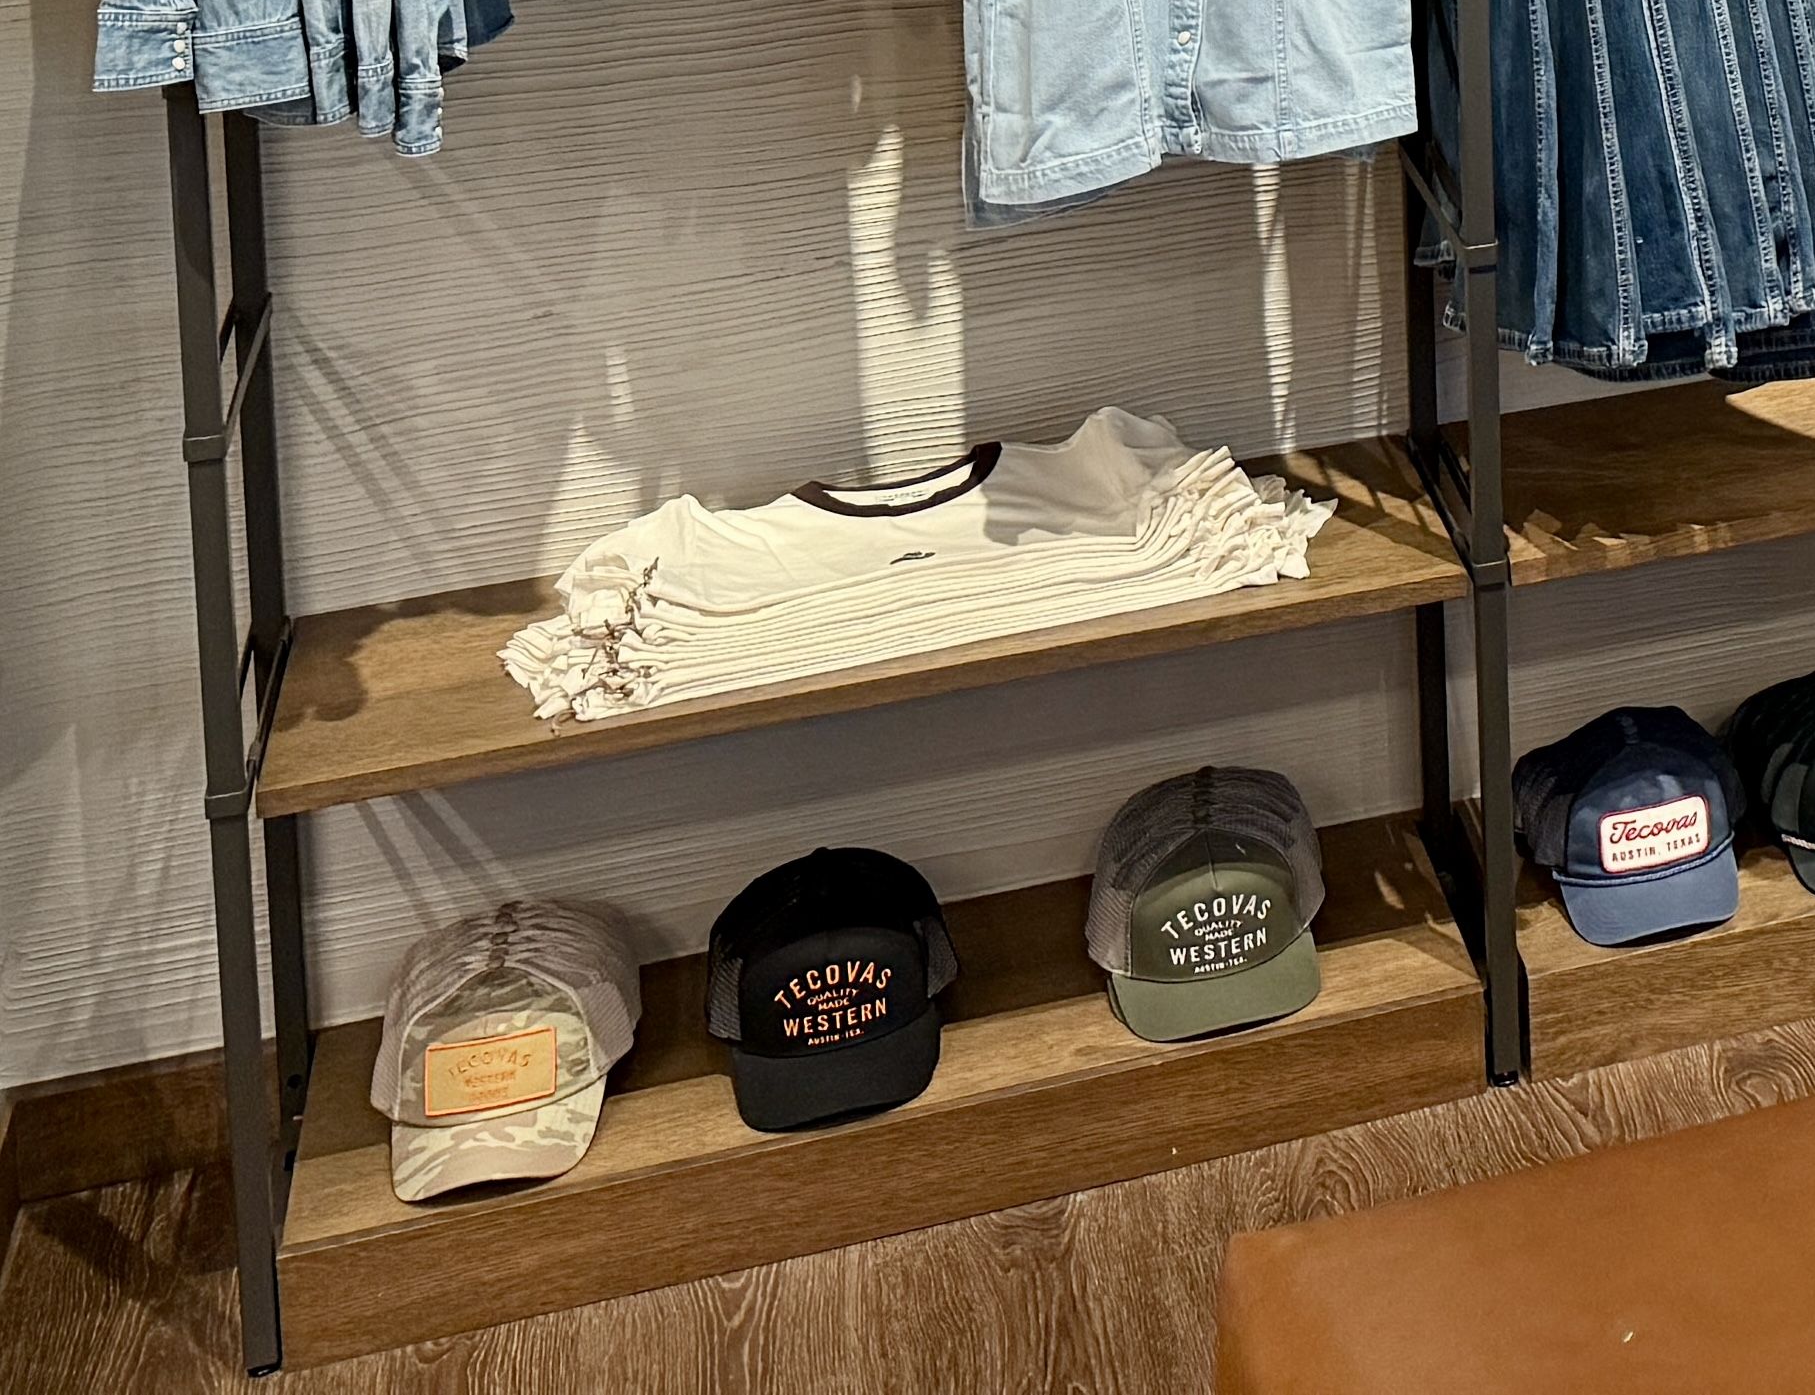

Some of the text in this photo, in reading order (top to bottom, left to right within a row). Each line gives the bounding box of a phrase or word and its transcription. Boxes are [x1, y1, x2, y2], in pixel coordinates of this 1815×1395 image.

[1609, 811, 1698, 845] Tecovas
[1666, 832, 1701, 852] TEXAS
[1160, 894, 1271, 939] TECOVAS
[1194, 919, 1243, 937] QUALITY
[1169, 927, 1267, 966] WESTERN
[1205, 928, 1235, 941] MADE
[774, 960, 892, 1009] TECOVAS
[807, 987, 860, 1006] QUALITY
[783, 997, 887, 1037] WESTERN
[818, 997, 851, 1011] MADE
